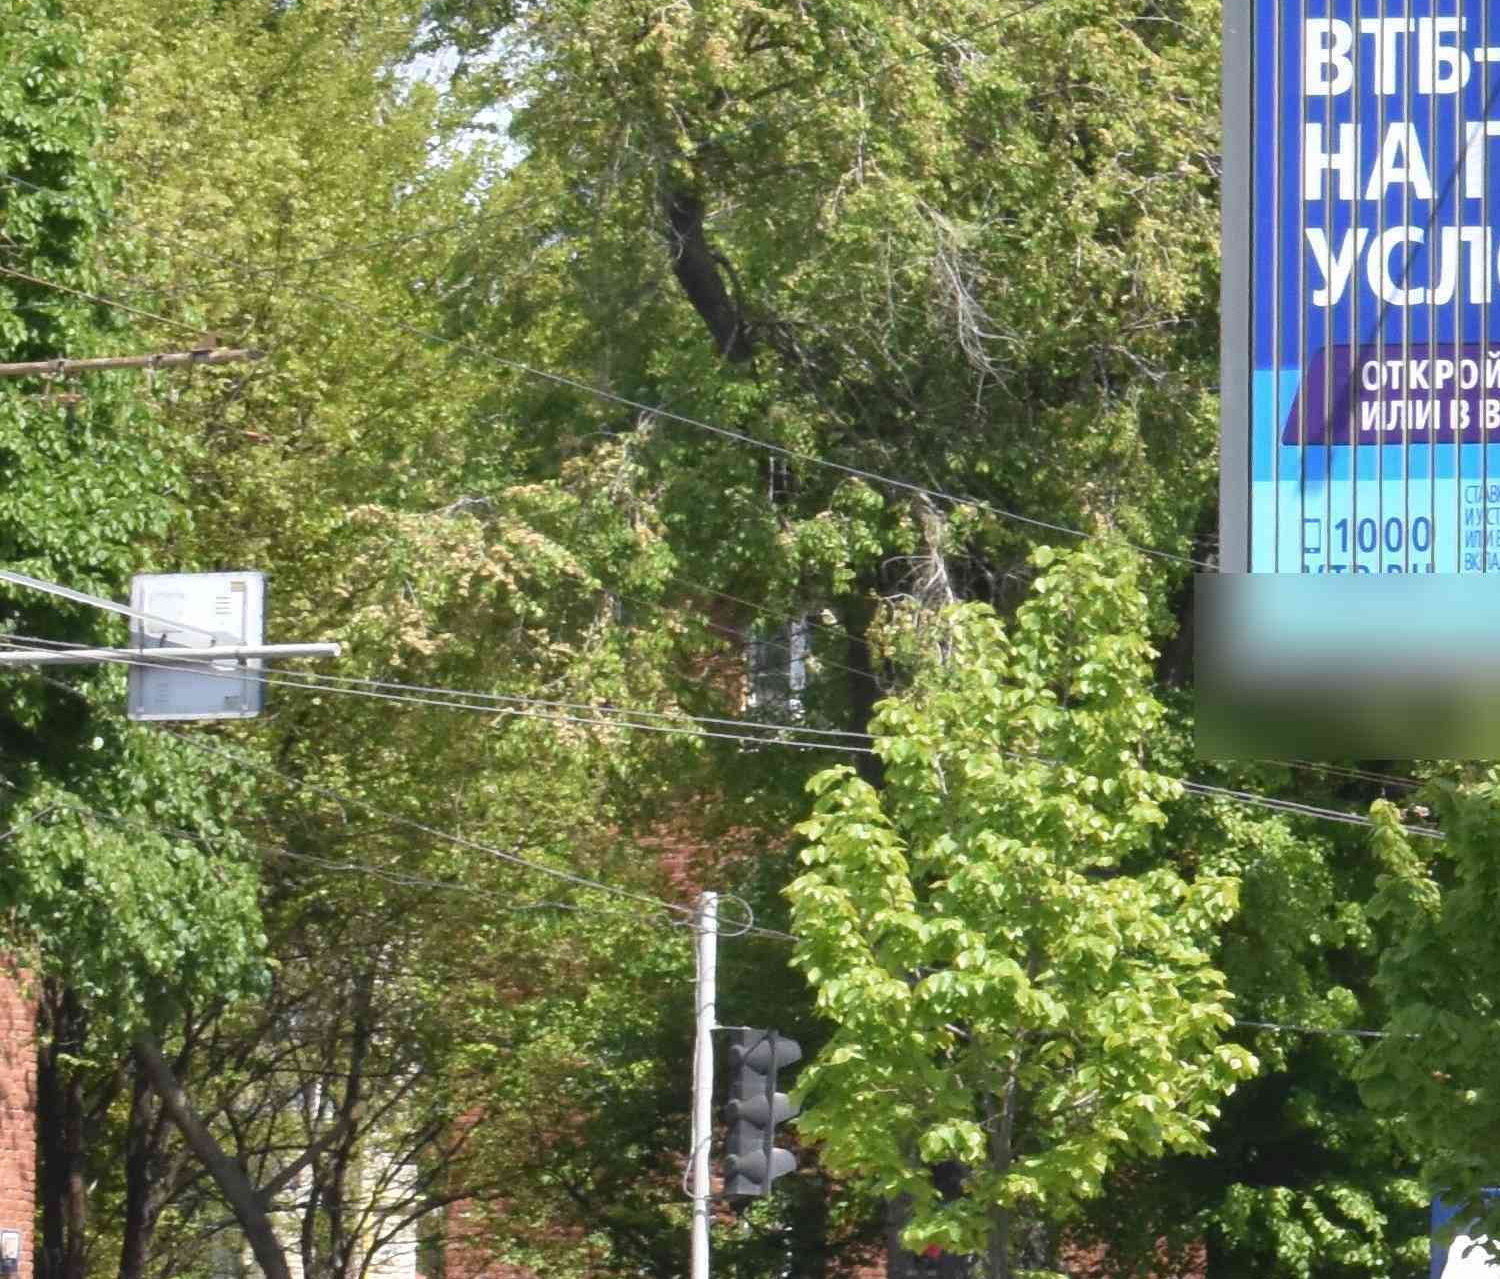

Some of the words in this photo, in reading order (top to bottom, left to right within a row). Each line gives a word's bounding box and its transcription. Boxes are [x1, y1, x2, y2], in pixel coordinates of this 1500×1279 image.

[1304, 121, 1438, 201] НА
[1360, 399, 1441, 432] ИЛИ
[1334, 517, 1432, 553] 1000
